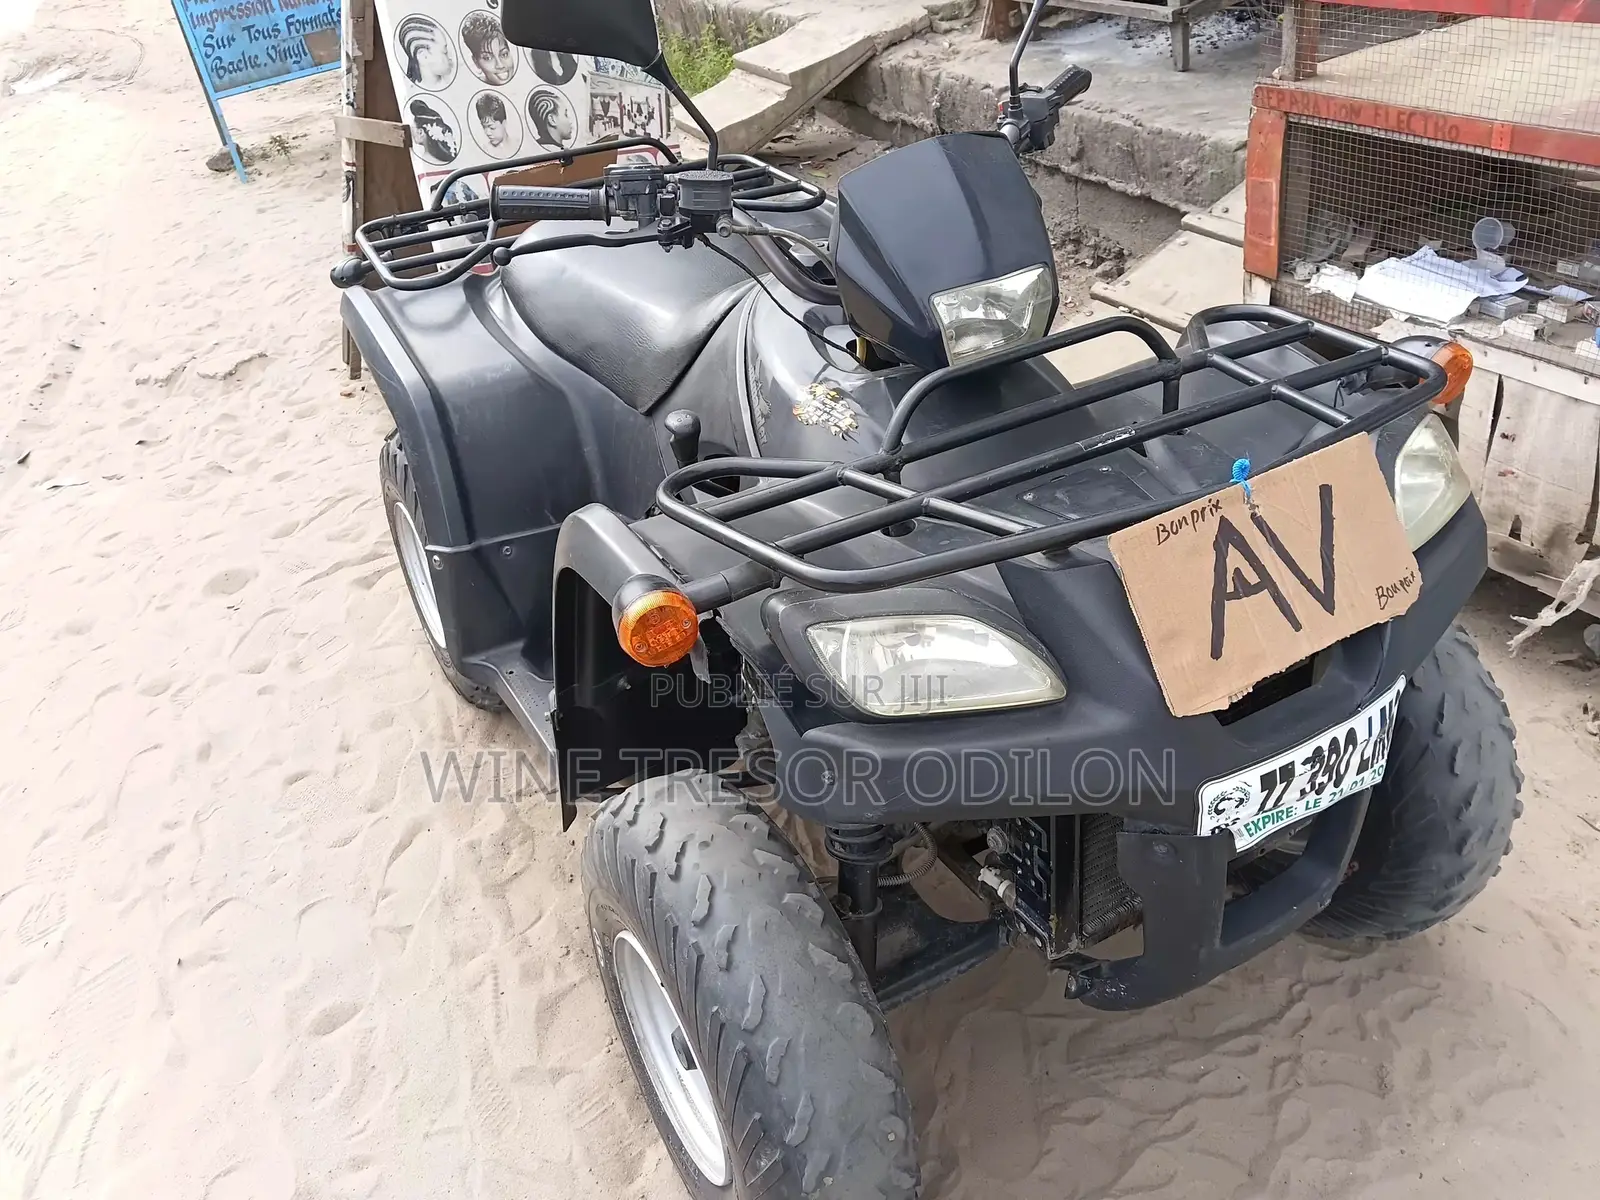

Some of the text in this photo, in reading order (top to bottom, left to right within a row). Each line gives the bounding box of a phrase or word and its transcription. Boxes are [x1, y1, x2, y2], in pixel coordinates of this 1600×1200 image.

[203, 33, 237, 59] Sur
[242, 22, 281, 44] Tous
[1210, 483, 1336, 661] AV
[1304, 797, 1322, 811] LE
